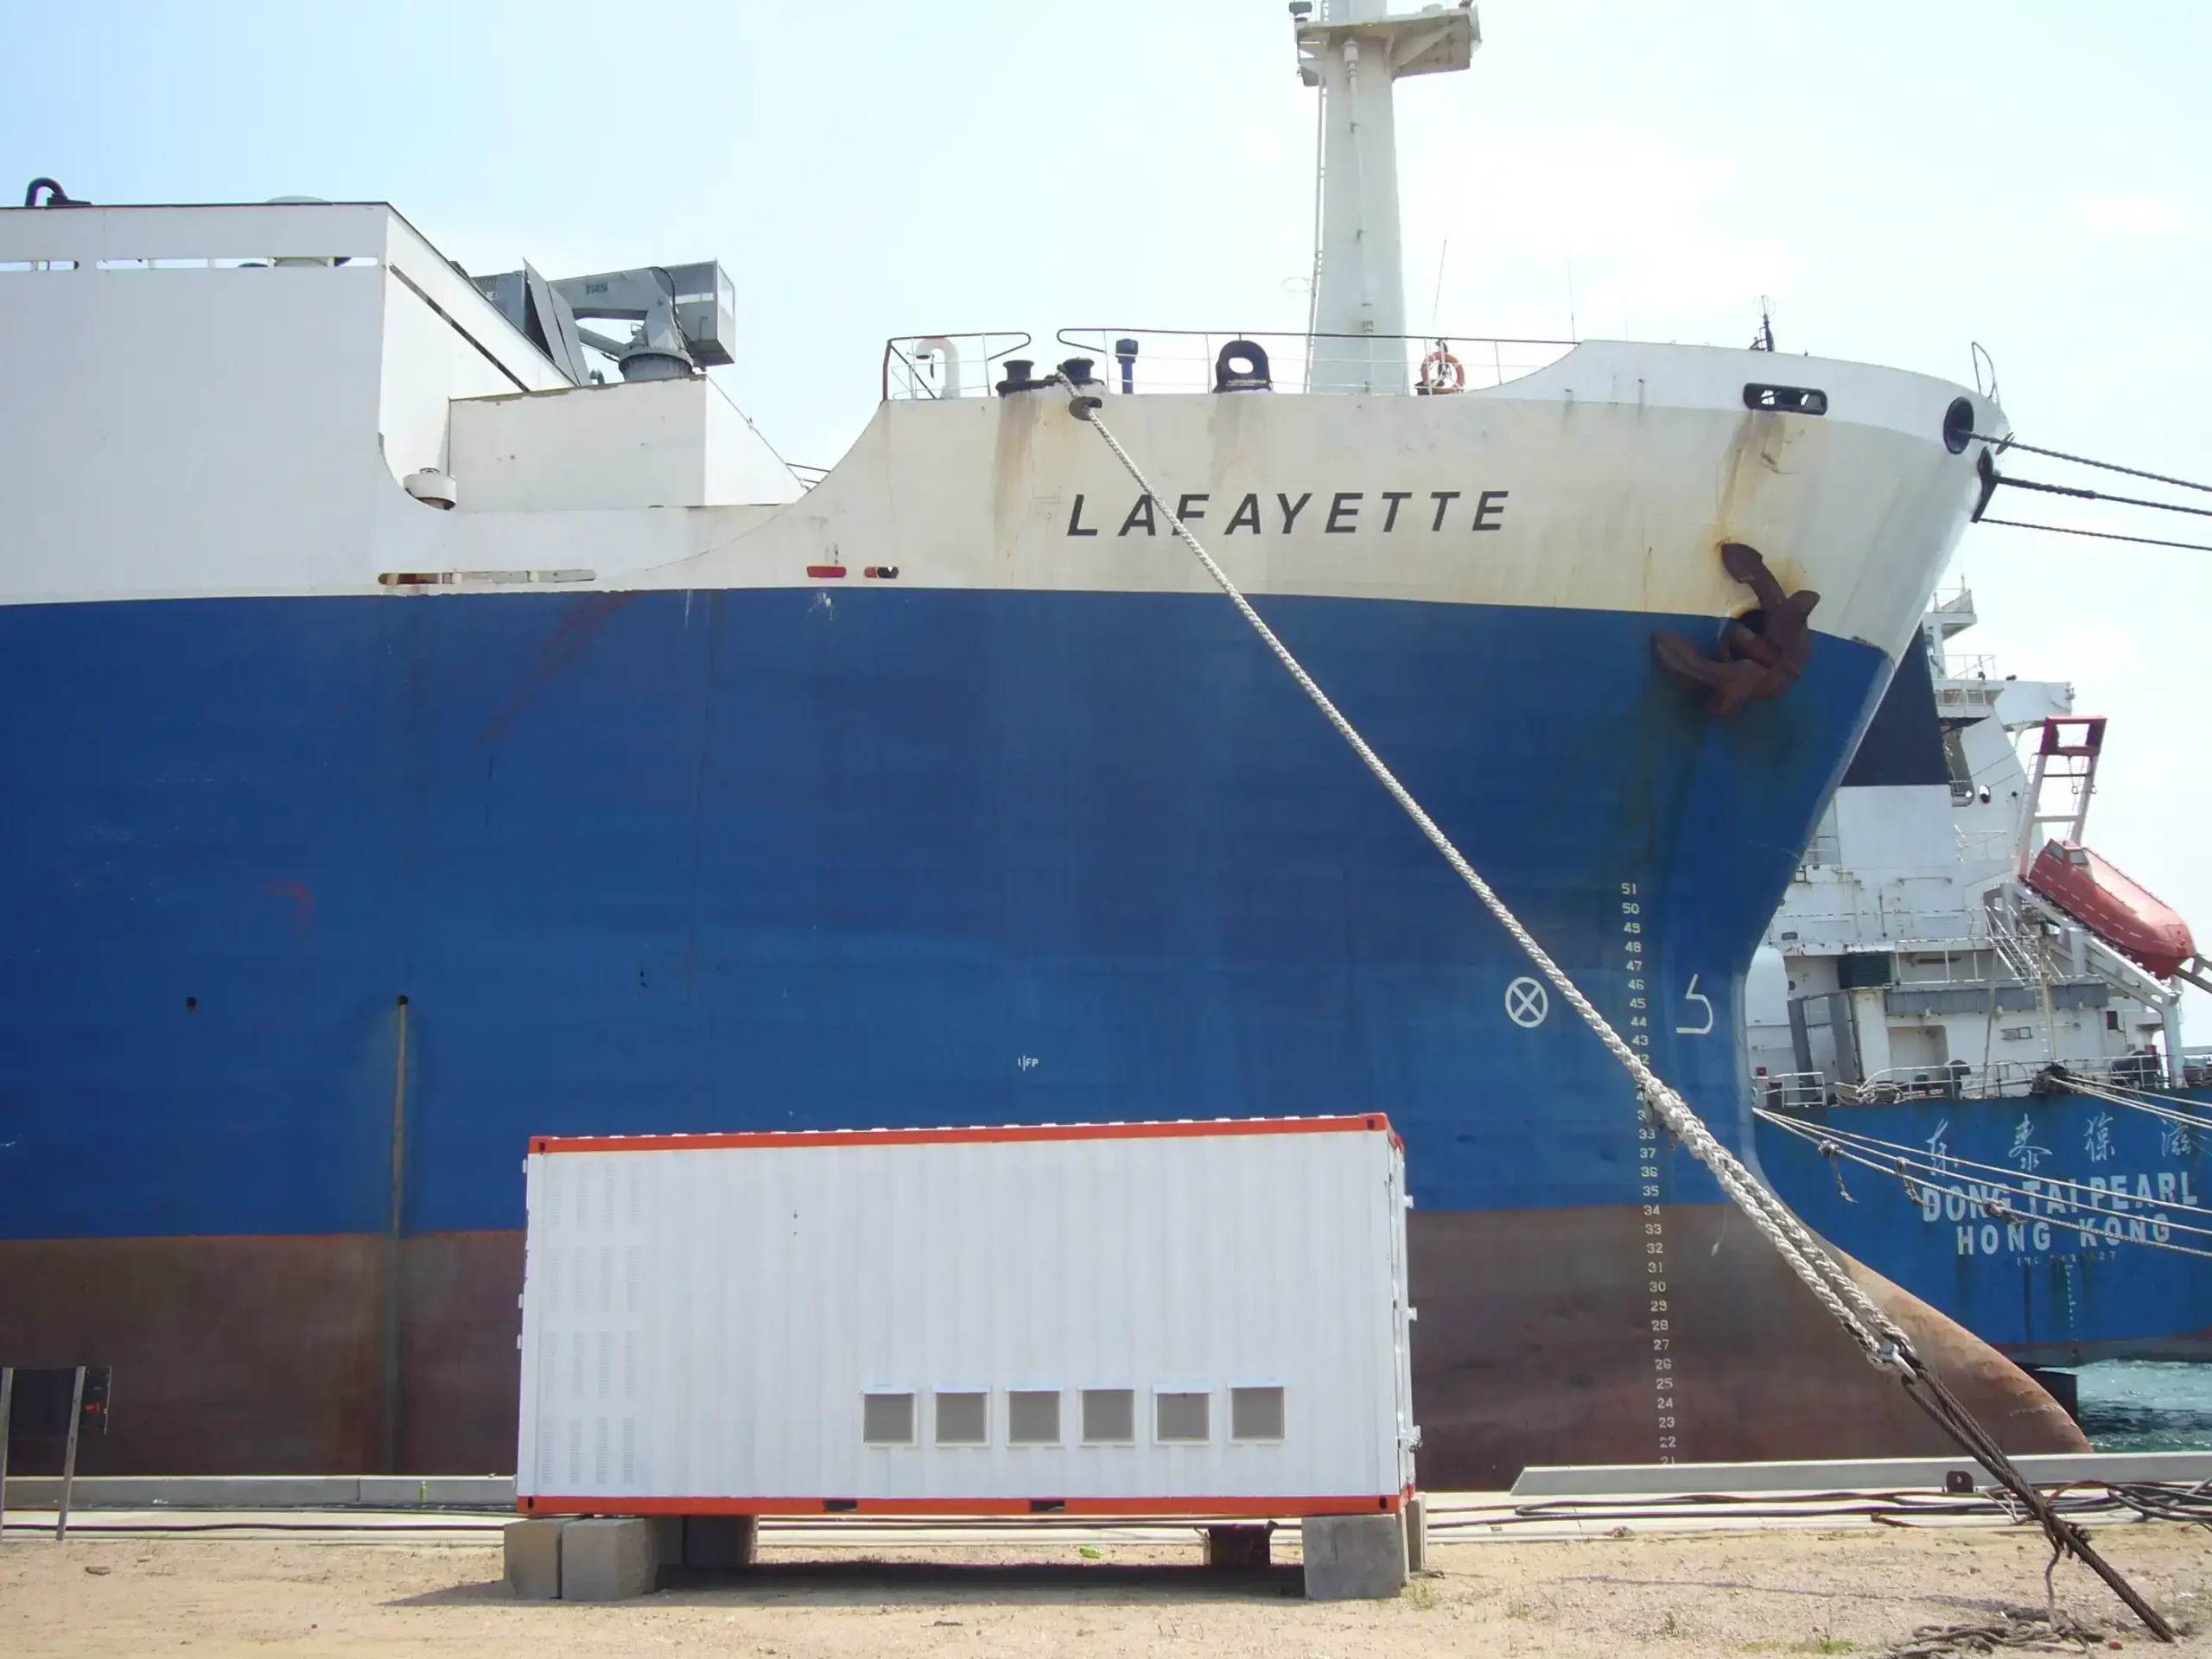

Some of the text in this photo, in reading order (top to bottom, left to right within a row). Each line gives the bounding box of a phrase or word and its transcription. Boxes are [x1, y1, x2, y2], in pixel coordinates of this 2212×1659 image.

[1067, 491, 1510, 537] LAFAYETTE
[1621, 882, 1637, 895] 51
[1622, 902, 1640, 915] 50
[1623, 922, 1641, 934] 49
[1624, 941, 1642, 953] 48
[1626, 960, 1643, 971] 47
[1627, 978, 1645, 990] 46
[1629, 997, 1646, 1009] 45
[1630, 1016, 1647, 1027] 44
[1631, 1034, 1649, 1047] 43
[1639, 1147, 1656, 1159] 37
[1640, 1166, 1658, 1178] 36
[1643, 1185, 1660, 1197] 35
[1922, 1171, 2198, 1223] DONG TAI PEARL
[1643, 1205, 1661, 1216] 34
[1644, 1223, 1662, 1235] 33
[1956, 1212, 2171, 1255] HONG KONG
[1646, 1242, 1663, 1254] 32
[1648, 1261, 1662, 1274] 31
[1649, 1281, 1667, 1293] 30
[1649, 1300, 1668, 1313] 29
[1651, 1319, 1669, 1332] 28
[1653, 1338, 1670, 1351] 27
[1655, 1357, 1672, 1370] 26
[1656, 1377, 1674, 1390] 25
[1656, 1396, 1674, 1409] 24
[1658, 1416, 1675, 1428] 23
[1659, 1435, 1677, 1449] 22
